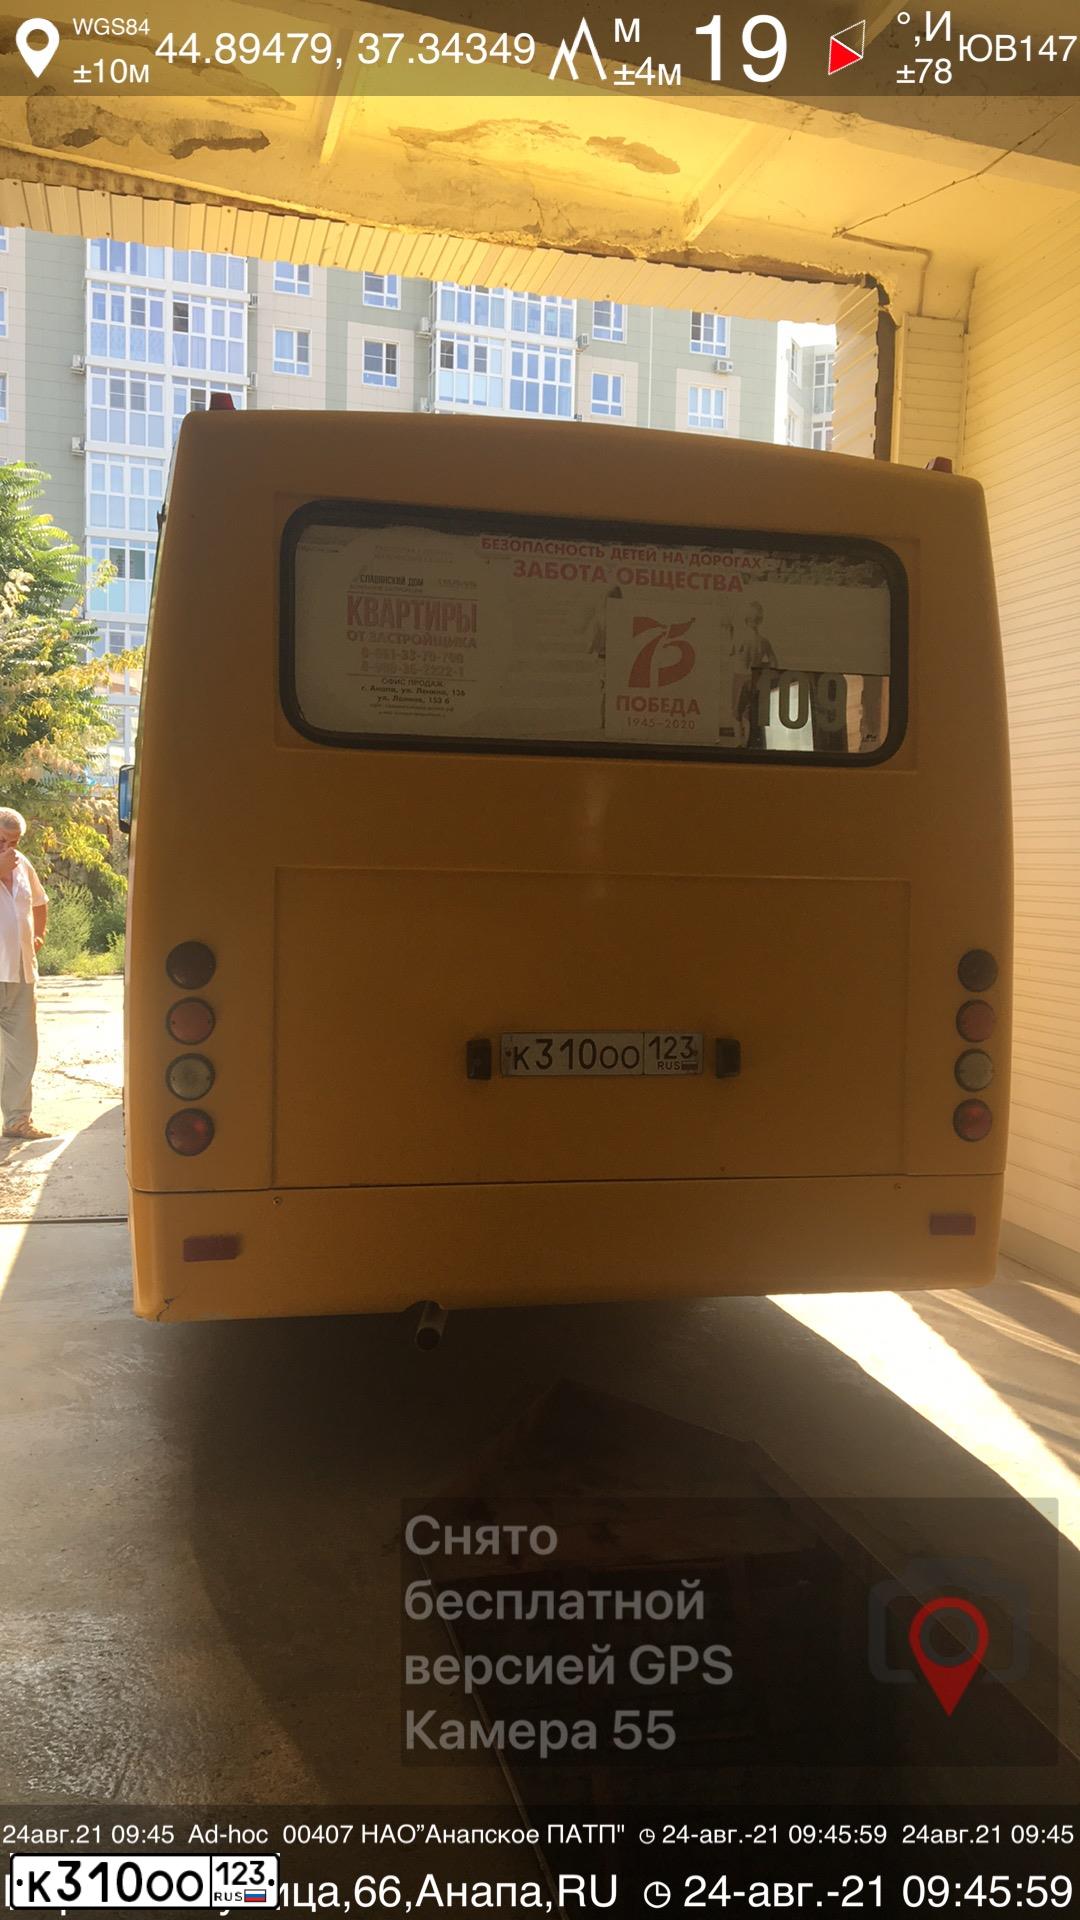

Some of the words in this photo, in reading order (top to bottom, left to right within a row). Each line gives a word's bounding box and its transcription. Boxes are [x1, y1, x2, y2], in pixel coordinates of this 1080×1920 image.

[481, 537, 606, 559] БЕЗОПАСНОСТЬ
[610, 546, 657, 562] ДЕТЕЙ
[662, 551, 684, 565] НА
[688, 552, 762, 569] ДОРОГАХ
[407, 576, 424, 587] ДОМ
[512, 560, 608, 583] ЗАБОТА
[615, 566, 744, 593] ОБЩЕСТВА
[346, 594, 477, 634] КВАРТИРЫ
[346, 630, 365, 643] ОТ
[367, 631, 478, 649] ЗАСТРОЙЩИКА
[628, 616, 697, 689] 75
[615, 694, 701, 716] ПОБЕДА
[647, 1035, 695, 1060] 123
[657, 1060, 681, 1071] RUS
